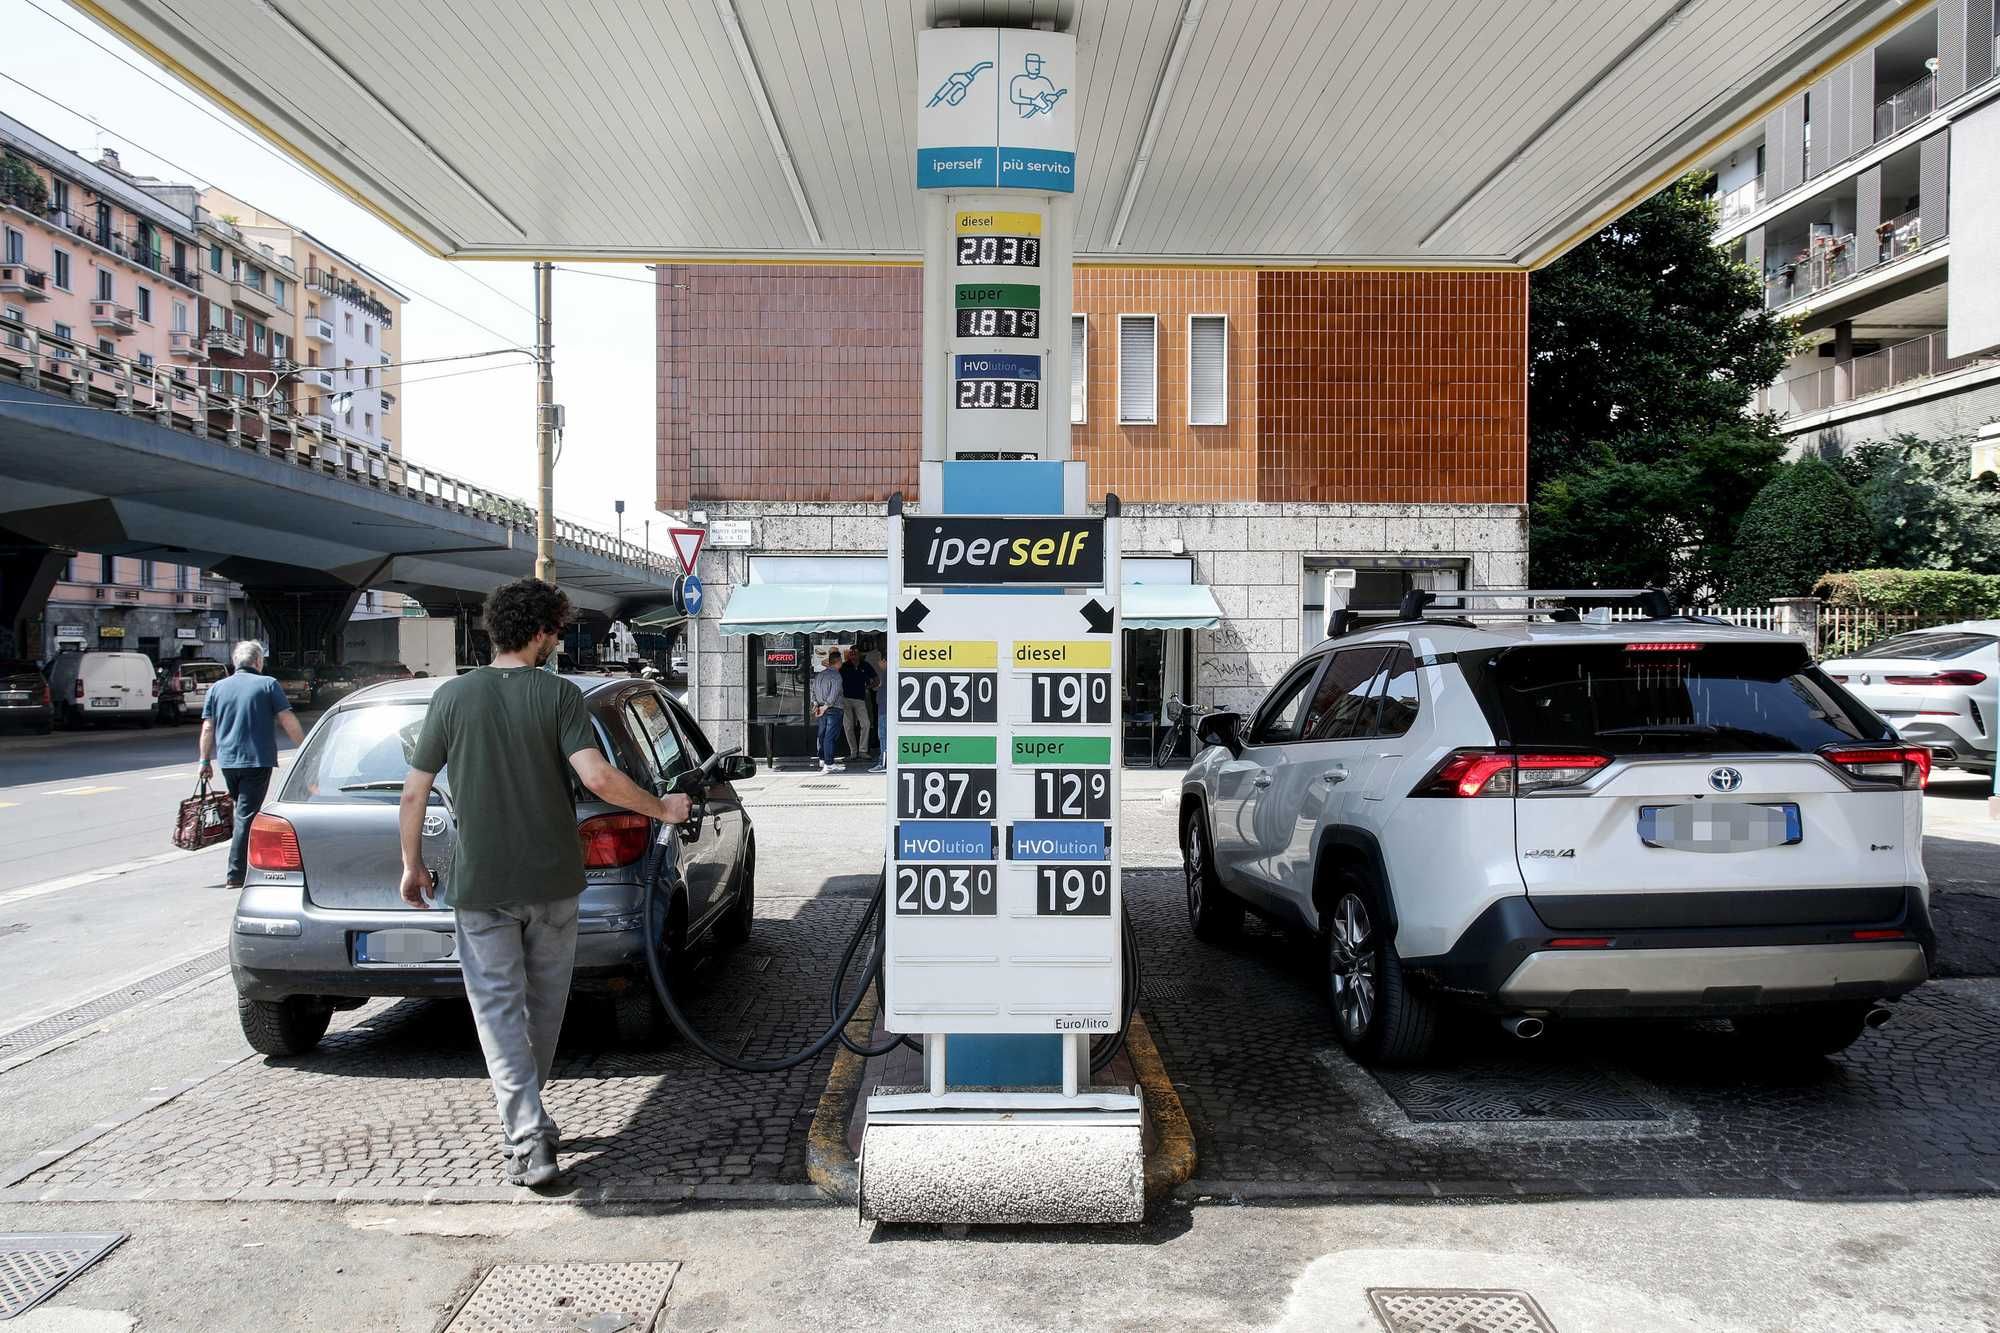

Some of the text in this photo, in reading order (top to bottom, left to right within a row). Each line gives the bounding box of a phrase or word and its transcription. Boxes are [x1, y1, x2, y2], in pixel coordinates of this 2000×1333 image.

[933, 159, 982, 172] iperself
[1003, 159, 1070, 174] più servito
[961, 216, 993, 227] diesel
[960, 238, 1038, 265] 2.030
[960, 289, 1003, 304] super
[964, 361, 1017, 372] HVOlution
[960, 381, 1037, 409] 2.030
[928, 526, 1089, 573] iperself
[767, 654, 794, 662] APERTO
[903, 645, 952, 660] diesel
[1016, 645, 1066, 660] diesel
[901, 740, 951, 757] super
[1015, 740, 1065, 757] super
[904, 839, 984, 854] HVOlution
[1017, 839, 1098, 854] HVOlution
[1524, 848, 1576, 858] RAV4
[1055, 1018, 1109, 1029] Euro/litro
